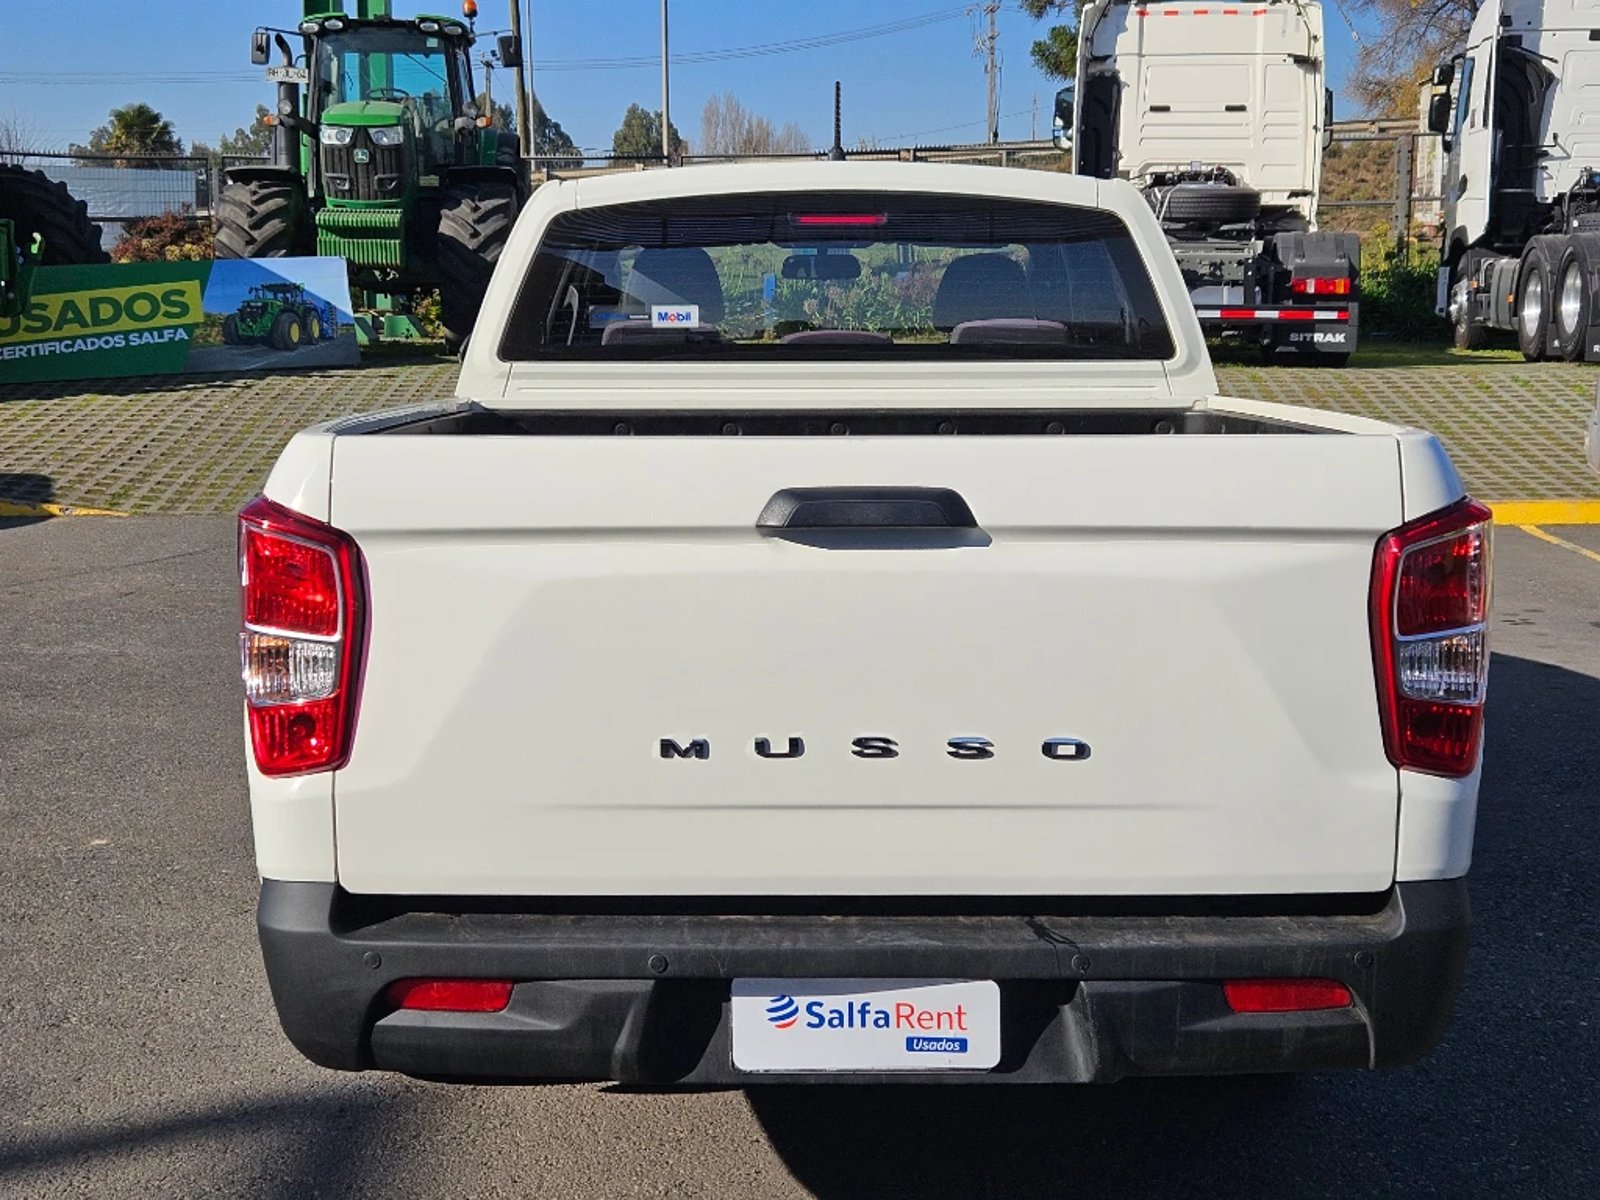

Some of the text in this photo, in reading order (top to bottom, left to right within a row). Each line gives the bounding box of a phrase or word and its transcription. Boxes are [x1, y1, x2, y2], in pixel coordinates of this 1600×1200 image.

[657, 311, 691, 322] Mobil
[0, 327, 189, 360] ERTIFICADOS SALFA
[1289, 332, 1346, 343] SITRAK
[660, 736, 1092, 760] MUSSO
[805, 1001, 968, 1031] SalfaRent
[912, 1037, 960, 1052] Usados
